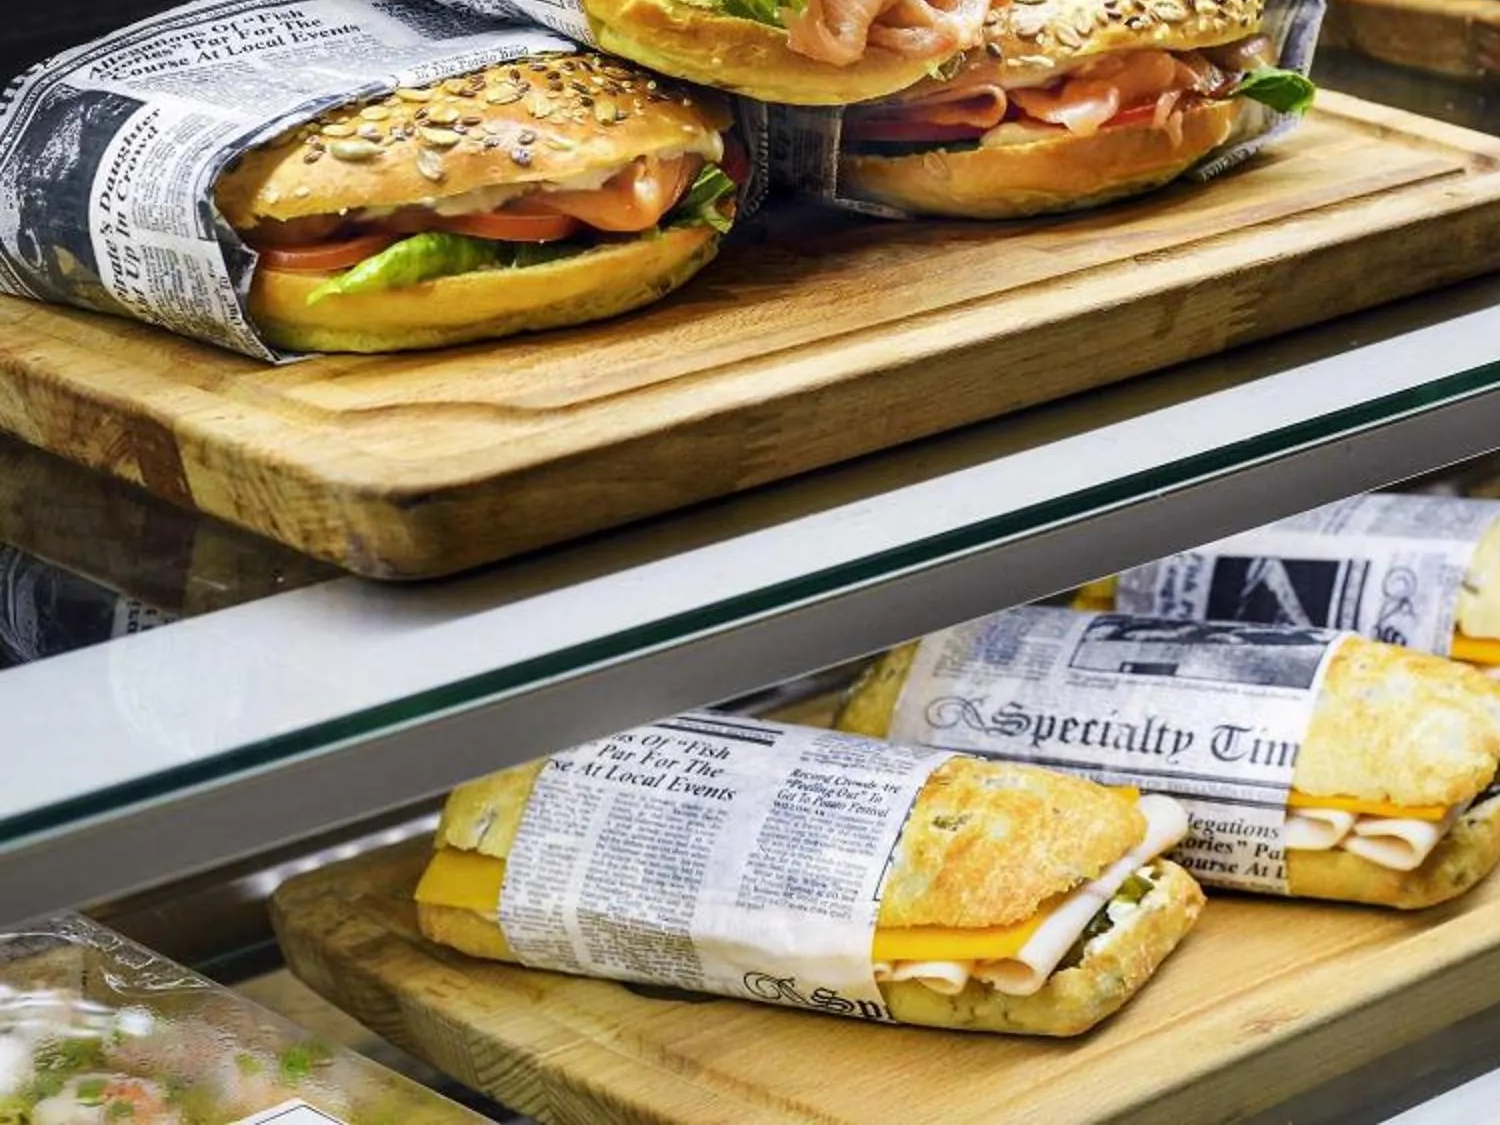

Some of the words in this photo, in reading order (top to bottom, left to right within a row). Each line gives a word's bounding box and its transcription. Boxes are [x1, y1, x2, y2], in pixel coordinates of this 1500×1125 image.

[190, 34, 230, 51] Par
[239, 25, 275, 41] For
[279, 17, 323, 31] The
[211, 21, 240, 36] Of
[111, 56, 191, 82] Course
[196, 50, 220, 64] At
[225, 35, 288, 58] Local
[291, 23, 363, 44] Events
[99, 107, 162, 213] Daughter
[115, 125, 160, 203] Crowd
[641, 733, 671, 750] Of
[989, 701, 1194, 764] Specialty
[596, 743, 636, 762] Par
[639, 750, 682, 770] For
[684, 758, 726, 779] The
[577, 760, 602, 777] At
[604, 764, 667, 789] Local
[667, 775, 737, 802] Events
[1244, 862, 1269, 878] At
